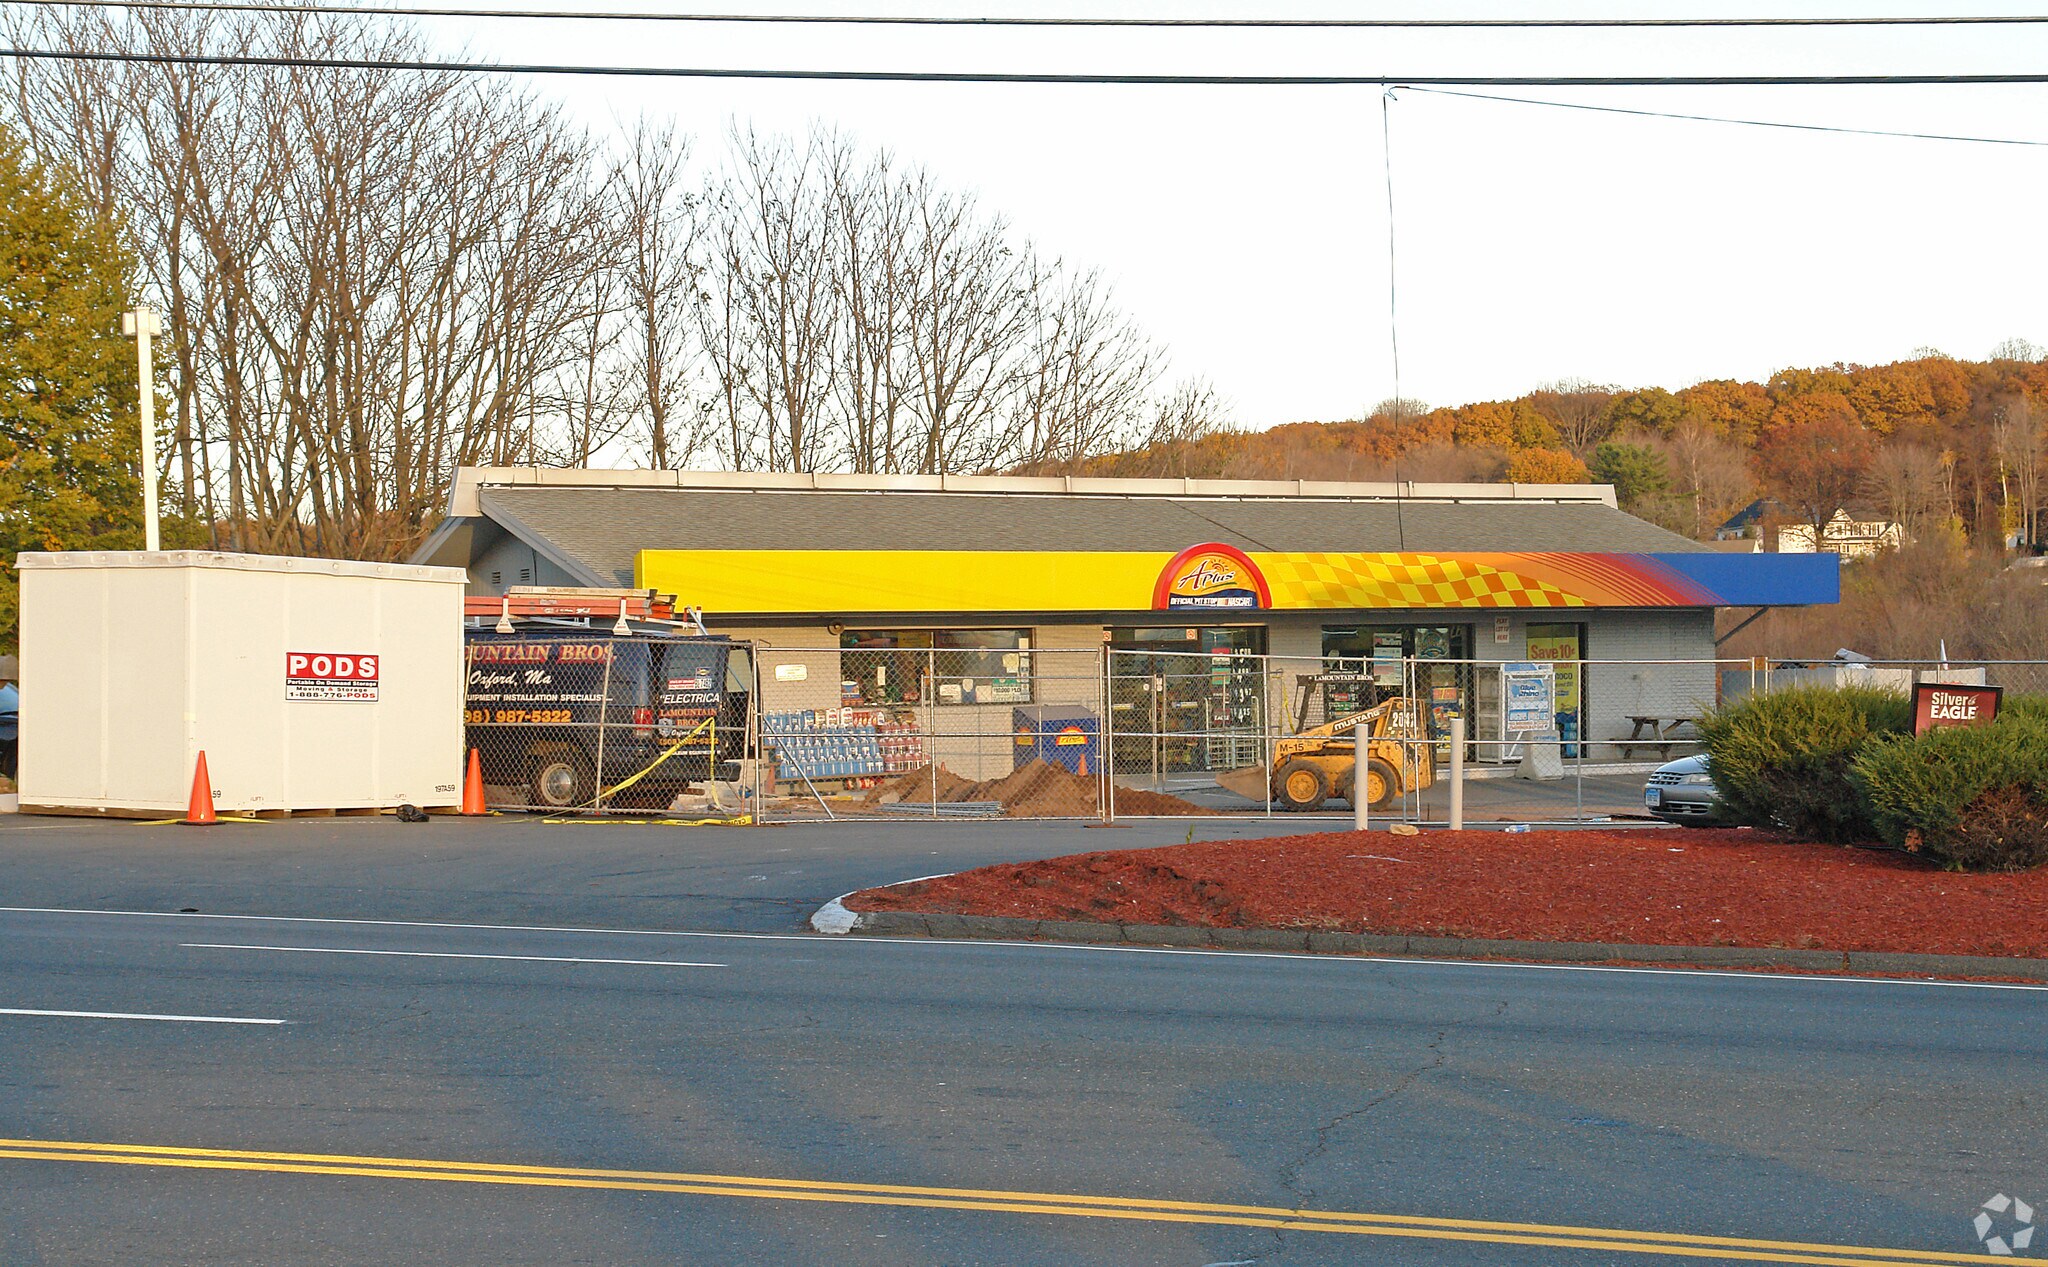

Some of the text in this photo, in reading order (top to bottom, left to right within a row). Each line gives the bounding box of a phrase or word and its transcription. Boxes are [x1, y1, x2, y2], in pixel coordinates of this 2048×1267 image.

[558, 645, 617, 662] BROS.
[1531, 645, 1558, 659] Save
[290, 655, 376, 678] PODS
[470, 669, 552, 690] Oxford, Ma
[503, 693, 558, 701] INSTALLATION
[1931, 691, 1969, 706] Silver
[495, 709, 572, 723] 987-5322
[1930, 705, 1977, 720] EAGLE
[1334, 710, 1380, 731] MUSTANG
[1280, 743, 1305, 752] M-15
